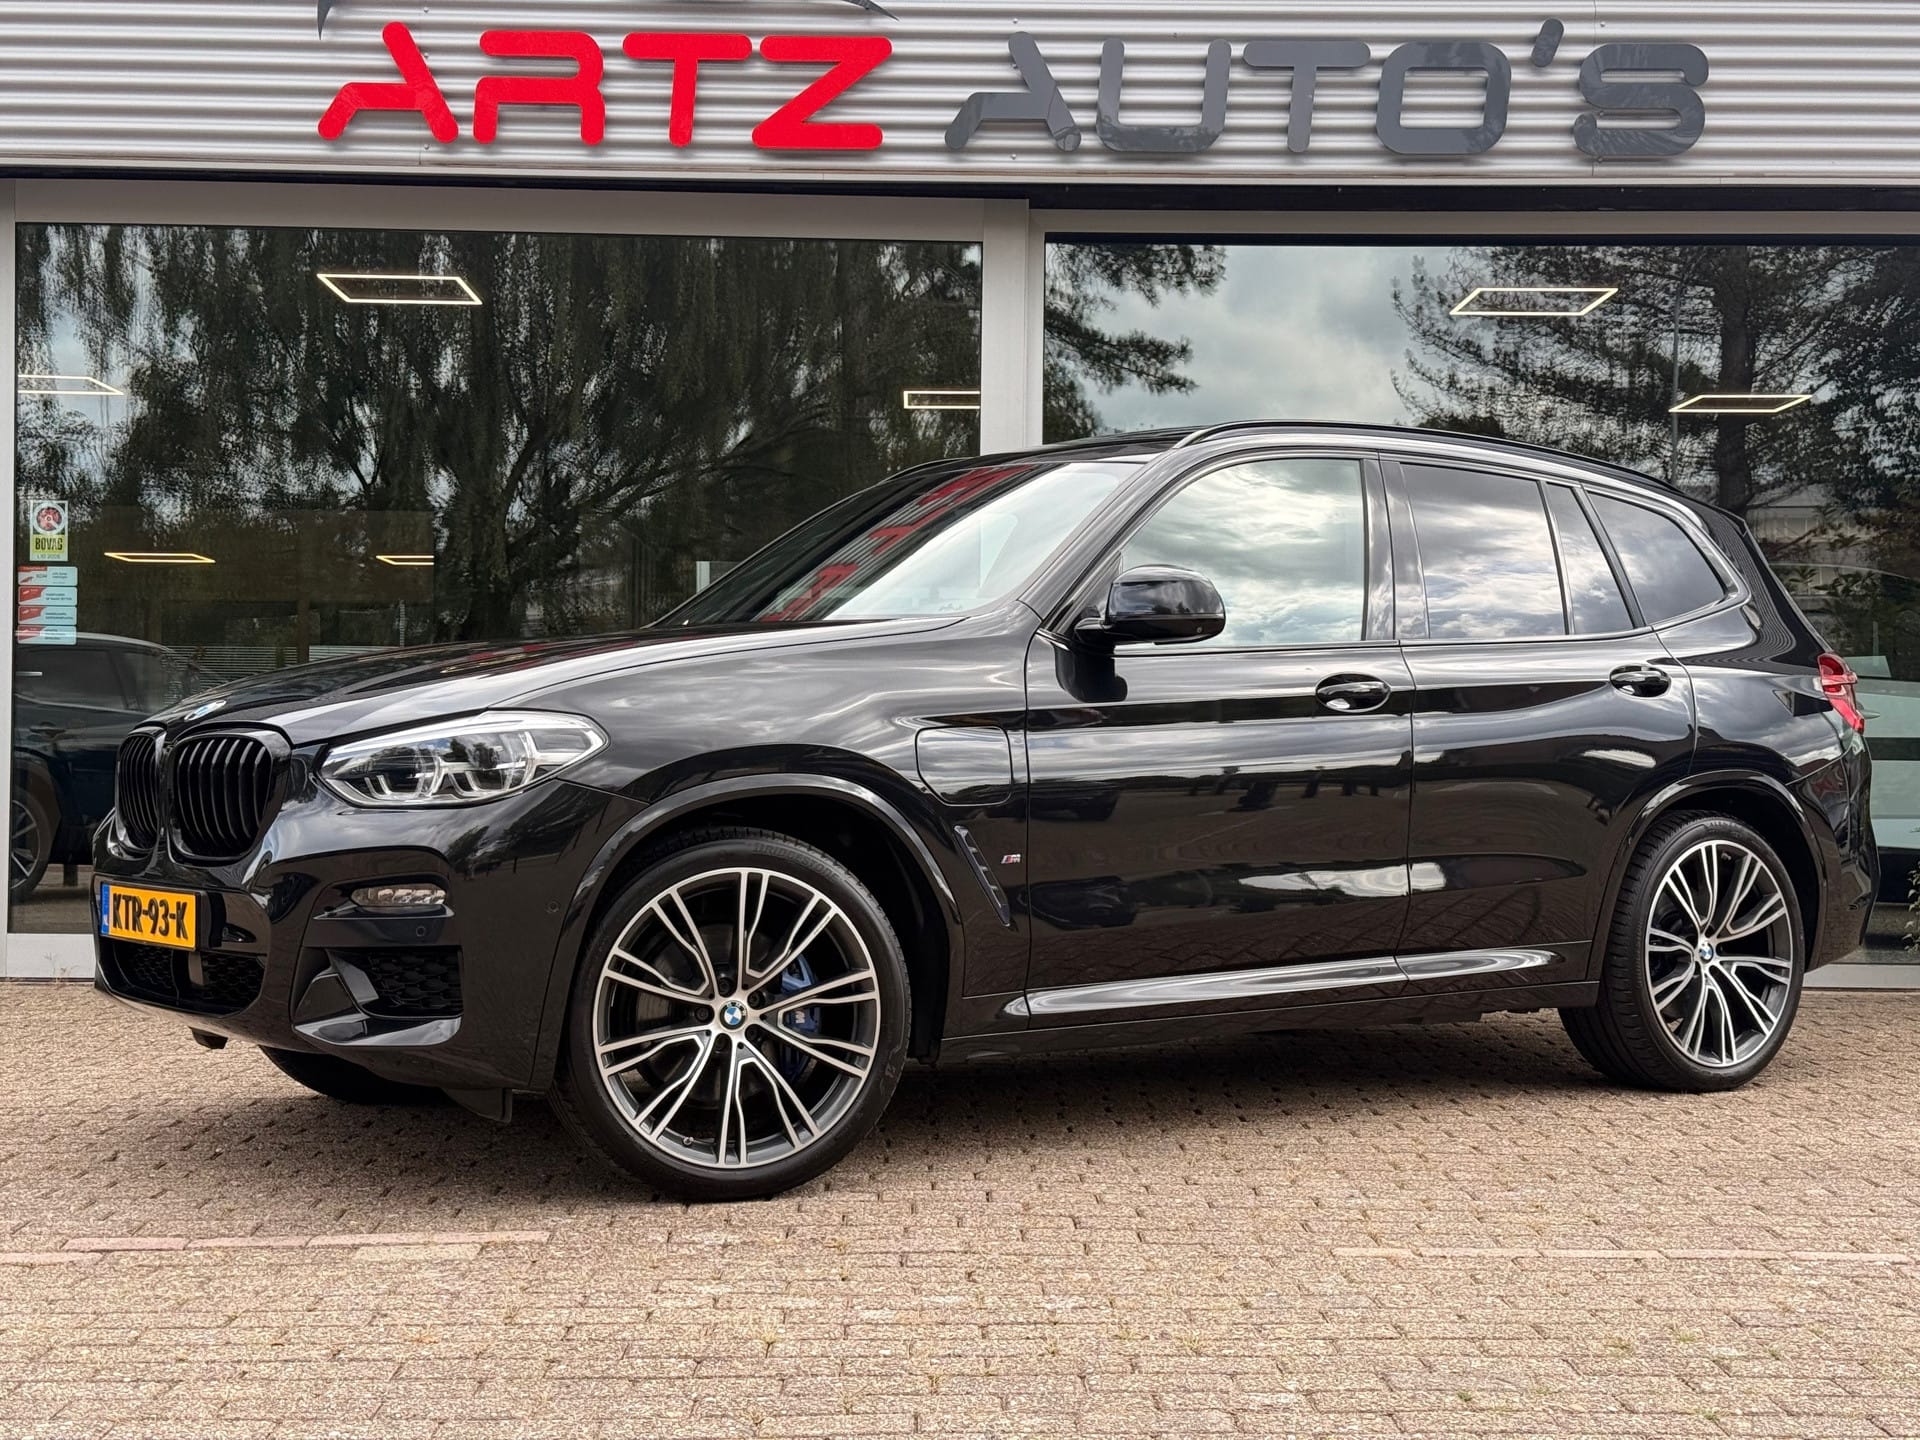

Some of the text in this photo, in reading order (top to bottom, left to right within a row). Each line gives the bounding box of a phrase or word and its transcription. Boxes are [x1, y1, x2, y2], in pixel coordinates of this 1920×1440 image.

[317, 18, 1709, 155] ARTZ AUTO'S
[35, 537, 63, 551] BOVAG
[112, 892, 189, 940] KTR-93-K
